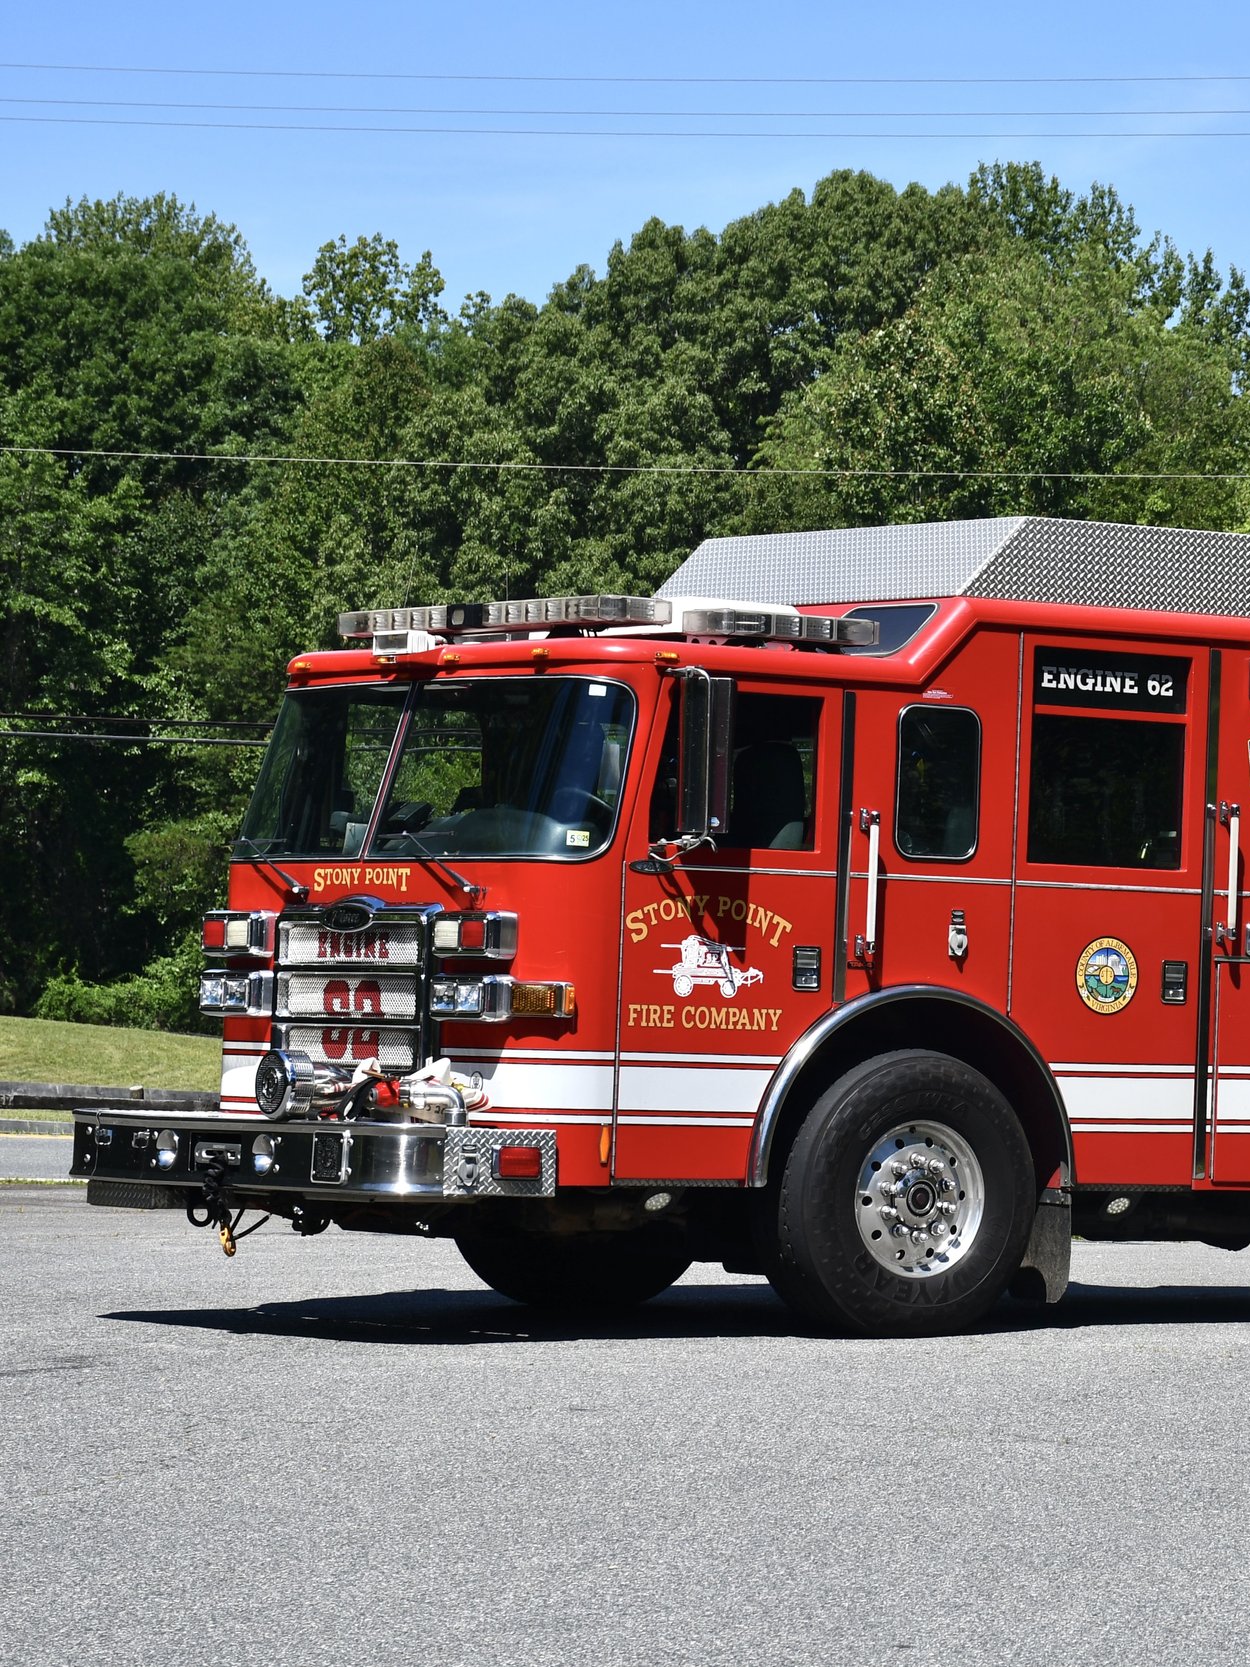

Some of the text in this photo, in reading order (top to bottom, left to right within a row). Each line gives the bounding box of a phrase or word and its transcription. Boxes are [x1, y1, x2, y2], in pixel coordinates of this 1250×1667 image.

[1041, 666, 1174, 697] ENGINE 62
[570, 834, 575, 843] 5
[313, 867, 411, 892] STONY POINT
[625, 895, 793, 949] STONY POINT
[318, 931, 390, 959] ENGINE
[1077, 938, 1137, 979] COUNTY OF ALBEMARLE
[321, 979, 385, 1060] 62
[627, 1004, 783, 1031] FIRE COMPANY
[1091, 999, 1124, 1013] VIRGINIA
